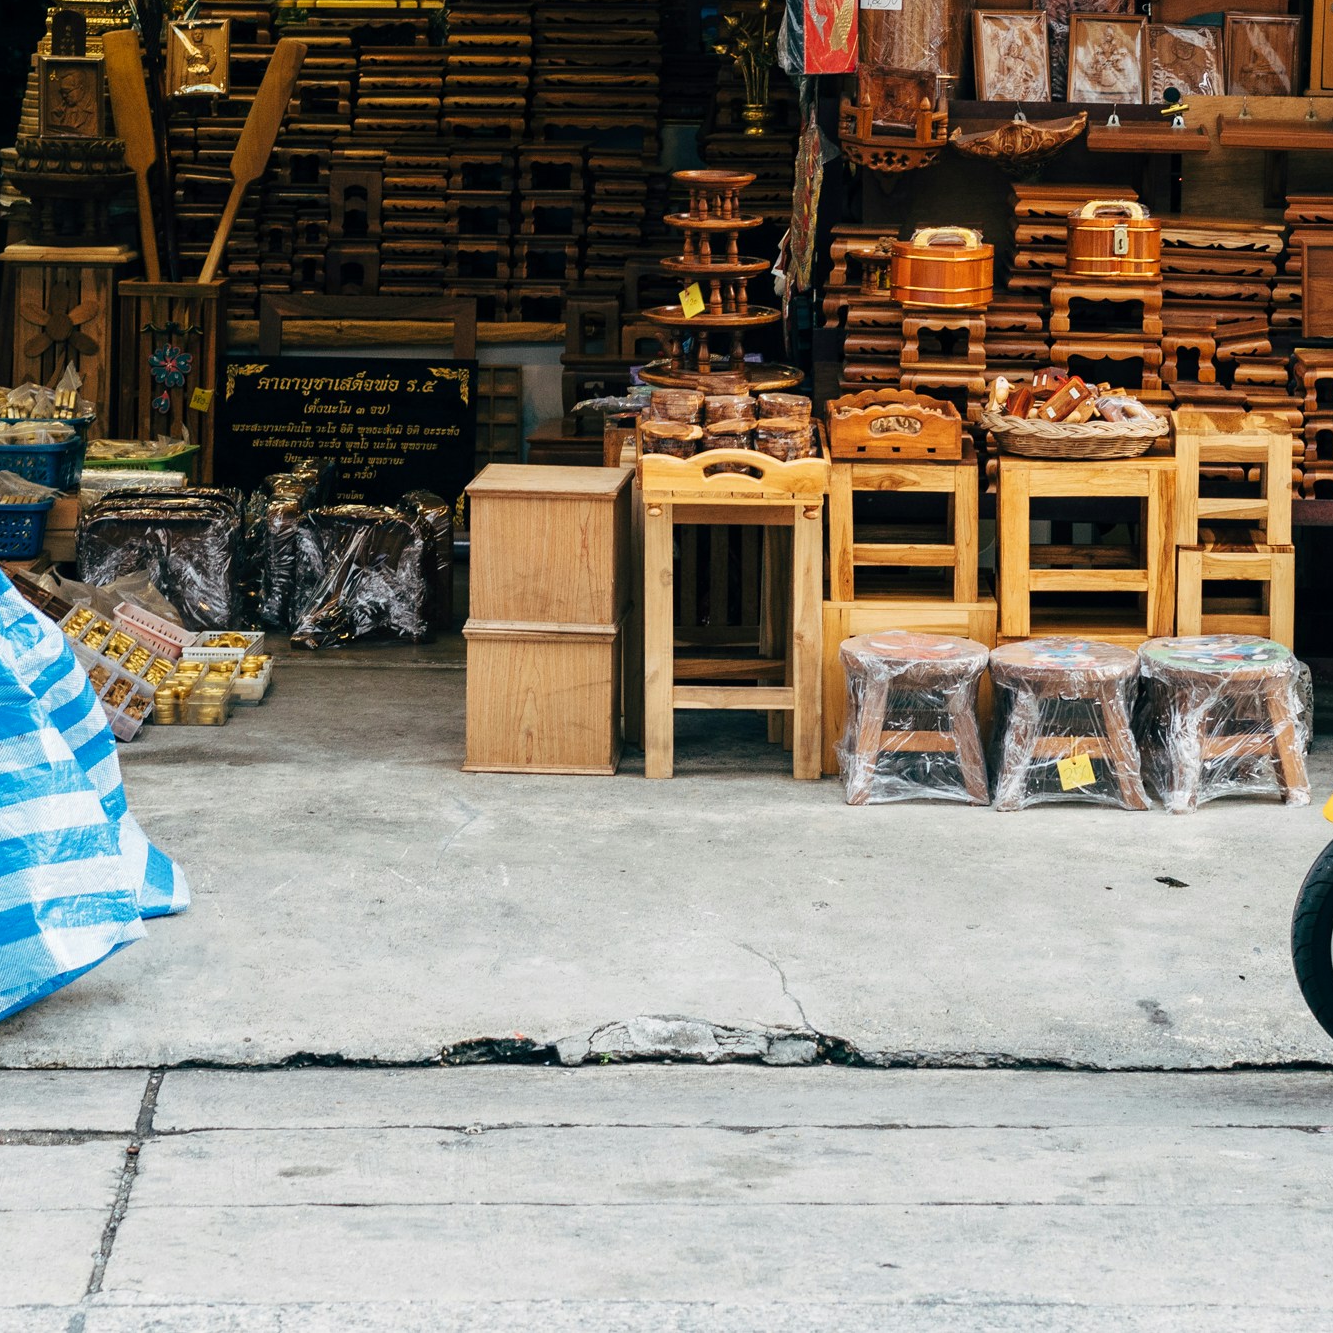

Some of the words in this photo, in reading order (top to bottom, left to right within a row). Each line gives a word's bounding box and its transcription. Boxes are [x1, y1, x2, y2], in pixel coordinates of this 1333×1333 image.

[257, 371, 401, 398] คาถาบูชาเสด็จพ่อ
